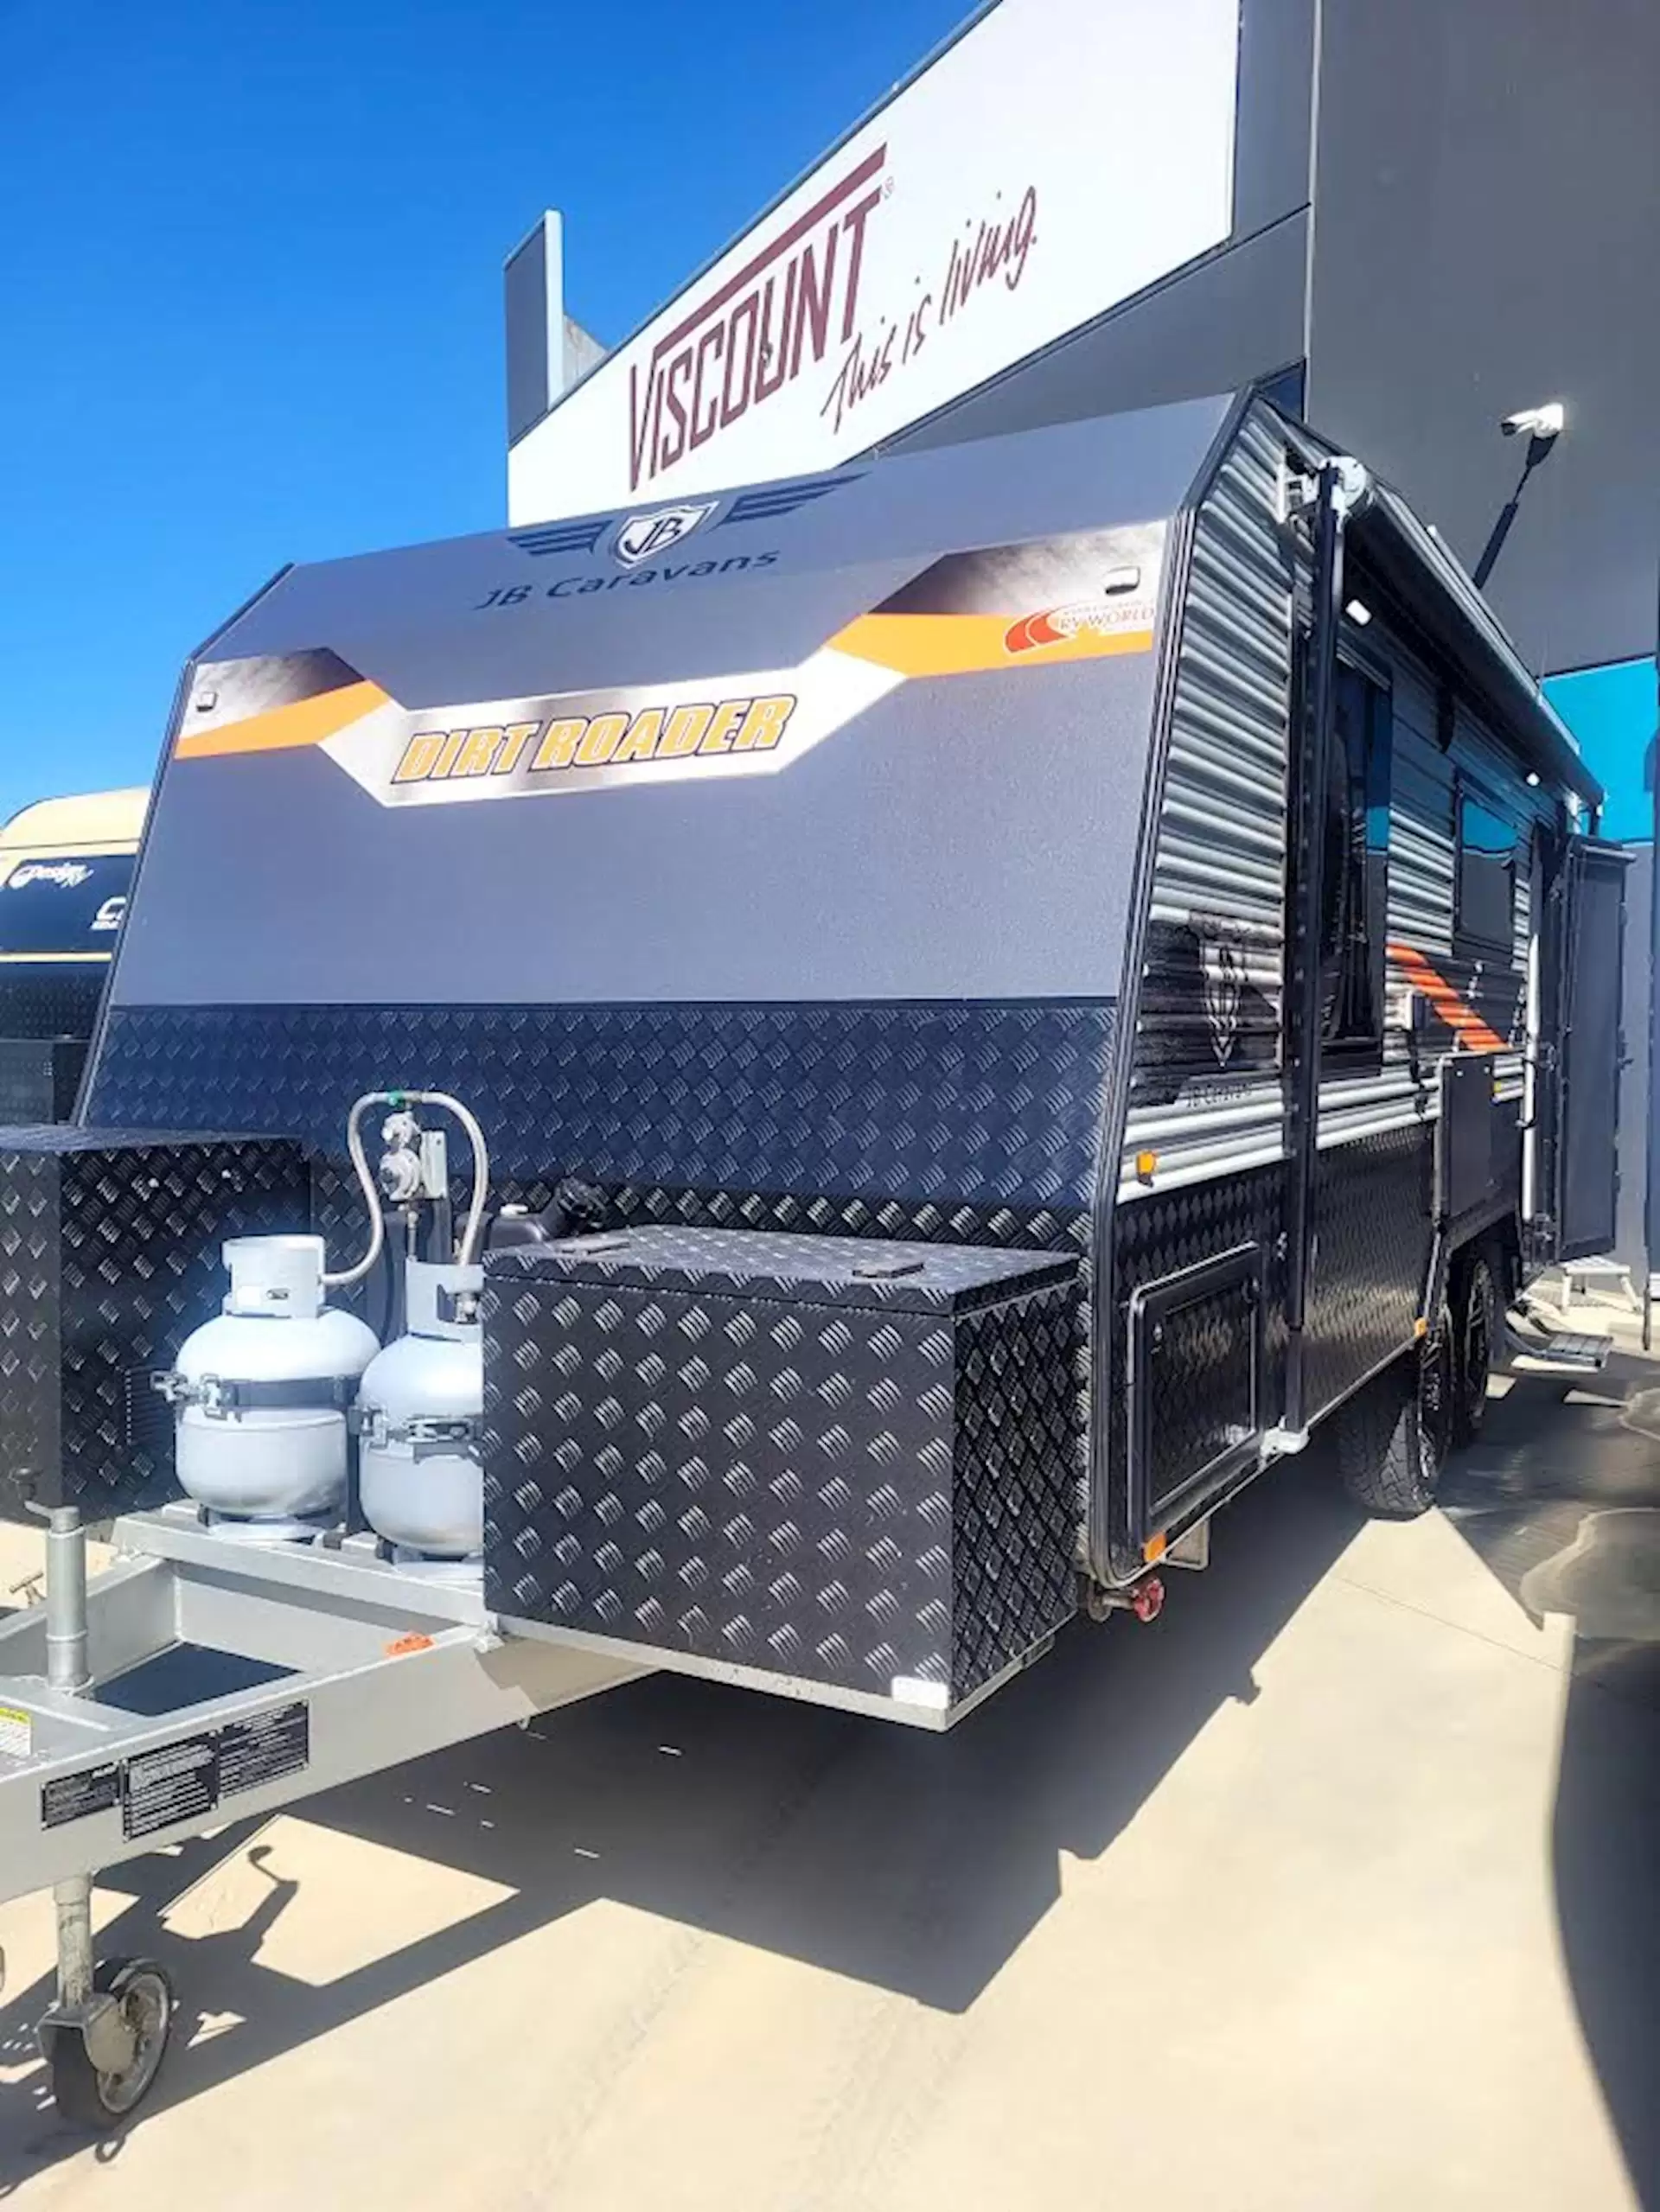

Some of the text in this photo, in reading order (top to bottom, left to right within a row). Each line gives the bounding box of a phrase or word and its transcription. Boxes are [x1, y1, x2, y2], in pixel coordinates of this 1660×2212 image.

[630, 185, 882, 493] VISCOUNT
[820, 316, 897, 435] This
[903, 276, 932, 365] is
[475, 550, 782, 610] JB Caravans
[624, 517, 682, 555] JB
[391, 694, 798, 785] DIRT ROADER
